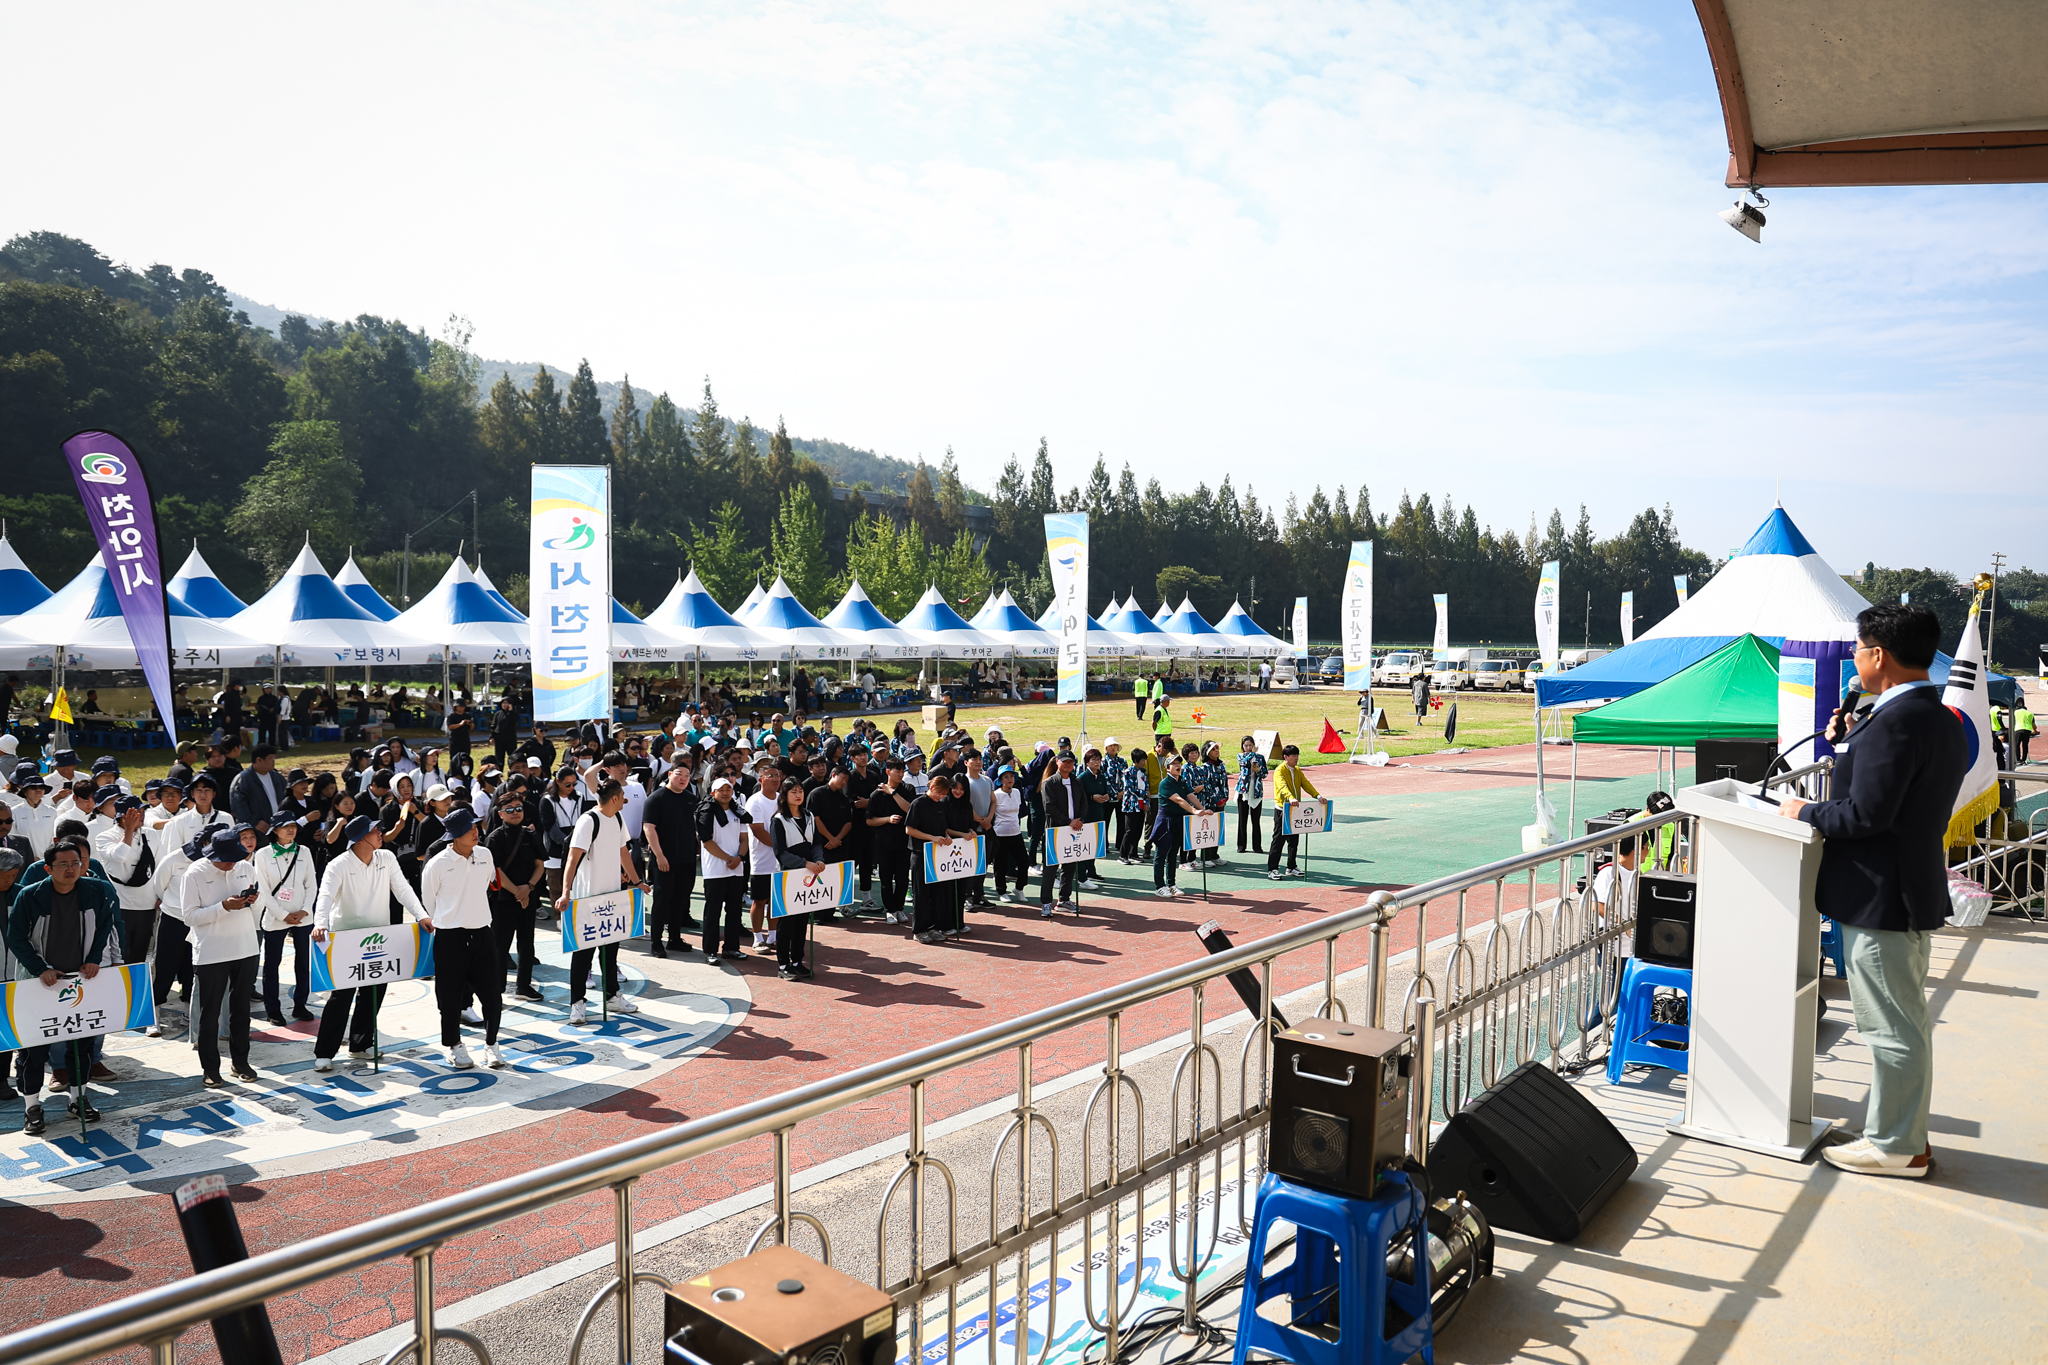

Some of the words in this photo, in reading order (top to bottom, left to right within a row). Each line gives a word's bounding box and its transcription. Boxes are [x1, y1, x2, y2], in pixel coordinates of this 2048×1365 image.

[354, 648, 400, 662] 보령시
[653, 648, 668, 658] 서산
[828, 647, 848, 657] 계룡시
[1293, 816, 1322, 829] 천안시
[1194, 829, 1215, 845] 공주시
[1063, 842, 1091, 859] 보령시
[940, 857, 972, 873] 아산시
[793, 885, 833, 906] 서산시
[583, 915, 626, 942] 논산시
[348, 958, 401, 981] 계룡시
[39, 1009, 107, 1038] 금산군
